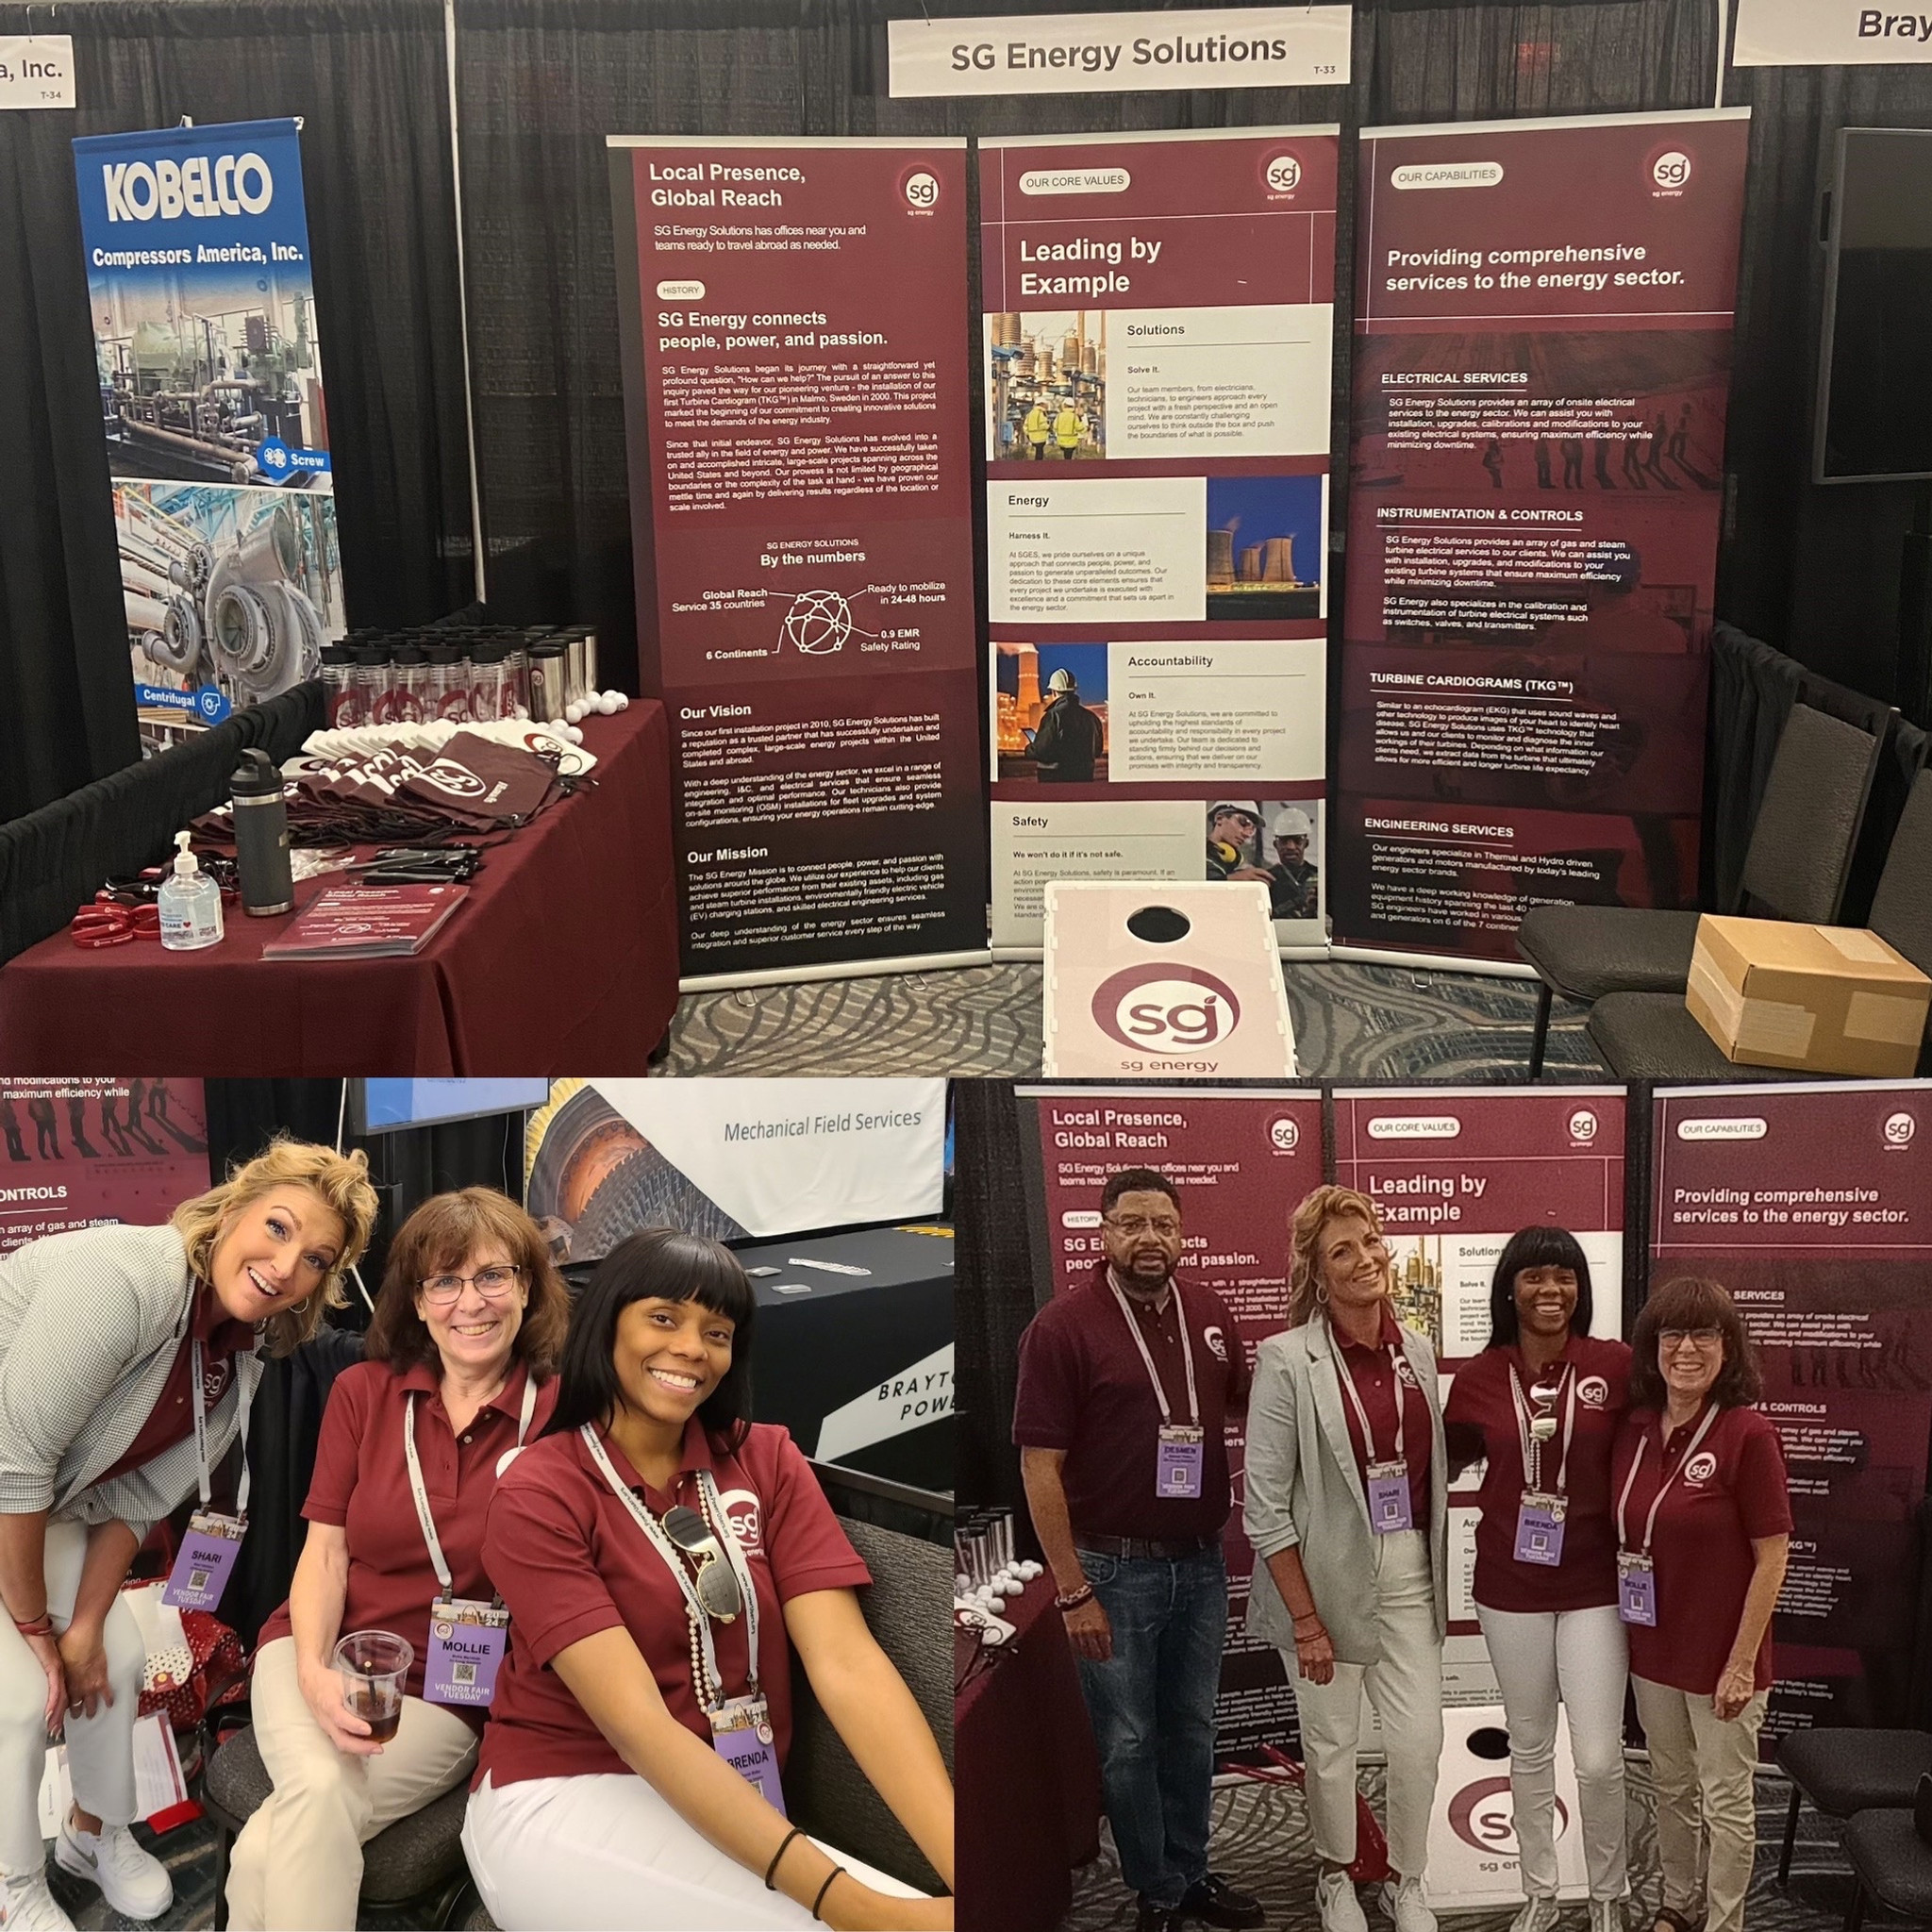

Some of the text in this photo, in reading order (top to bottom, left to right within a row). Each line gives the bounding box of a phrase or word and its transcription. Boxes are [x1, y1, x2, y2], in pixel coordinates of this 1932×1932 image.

[1858, 9, 1932, 43] Bray
[950, 34, 1287, 74] SG Energy Solutions
[23, 58, 62, 77] Inc.
[1313, 64, 1337, 75] T-33
[40, 91, 62, 100] T-34
[649, 163, 805, 183] Local Presence,
[1270, 162, 1298, 189] sg
[1398, 169, 1496, 182] OUR CAPABILITIES
[1657, 158, 1687, 183] sg
[102, 151, 274, 223] KOBELCO
[1025, 175, 1124, 187] OUR CORE VALUES
[651, 189, 781, 206] Global Reach
[909, 180, 934, 204] sg
[654, 225, 866, 238] SG Energy Solutions has offices near you and
[92, 242, 303, 269] Compressors America, Inc.
[1021, 236, 1161, 264] Leading by
[1388, 243, 1645, 267] Providing comprehensive
[1021, 270, 1129, 297] Example
[1386, 269, 1684, 291] services to the energy sector.
[658, 310, 826, 328] SG Energy connects
[1126, 324, 1184, 335] Solutions
[658, 330, 887, 351] people, power, and passion.
[1381, 372, 1527, 383] ELECTRICAL SERVICES
[291, 453, 324, 466] Screw
[1008, 494, 1049, 508] Energy
[1377, 508, 1583, 521] INSTRUMENTATION & CONTROLS
[814, 538, 858, 547] SOLUTIONS
[760, 550, 865, 568] By the numbers
[702, 588, 767, 600] Global Reach
[867, 581, 945, 594] Ready to mobilize
[672, 598, 765, 611] Service 35 countries
[880, 593, 945, 604] in 24-48 hours
[880, 628, 920, 639] 0.9 EMR
[706, 648, 768, 659] 6 Continents
[860, 640, 920, 652] Safety Rating
[1127, 655, 1213, 667] Accountability
[1370, 672, 1573, 693] TURBINE CARDIOGRAMS (TKG™)
[143, 689, 195, 707] Centrifugal
[680, 704, 751, 719] Our Vision
[1012, 816, 1048, 828] Safety
[1364, 817, 1513, 837] ENGINEERING SERVICES
[687, 846, 768, 863] Our Mission
[1128, 994, 1217, 1045] sg
[1121, 1061, 1218, 1072] sg energy
[2, 1087, 129, 1099] maximum efficiency while
[724, 1109, 923, 1141] Mechanical Field Services
[1052, 1109, 1186, 1128] Local Presence,
[1274, 1126, 1295, 1145] sg
[1373, 1123, 1455, 1132] OUR CORE VALUES
[1572, 1117, 1594, 1138] sg
[1887, 1121, 1911, 1140] sg
[1055, 1131, 1167, 1147] Global Reach
[1368, 1174, 1486, 1198] Leading by
[1674, 1187, 1878, 1206] Providing comprehensive
[1371, 1202, 1460, 1225] Example
[1201, 1251, 1258, 1268] passion.
[1584, 1384, 1606, 1404] sg
[1690, 1458, 1713, 1479] sg
[730, 1507, 758, 1540] sg
[191, 1550, 223, 1564] SHARI
[485, 1619, 499, 1627] 24
[441, 1641, 491, 1655] MOLLIE
[434, 1683, 491, 1696] VENDOR FAIR
[443, 1690, 481, 1702] TUESDAY
